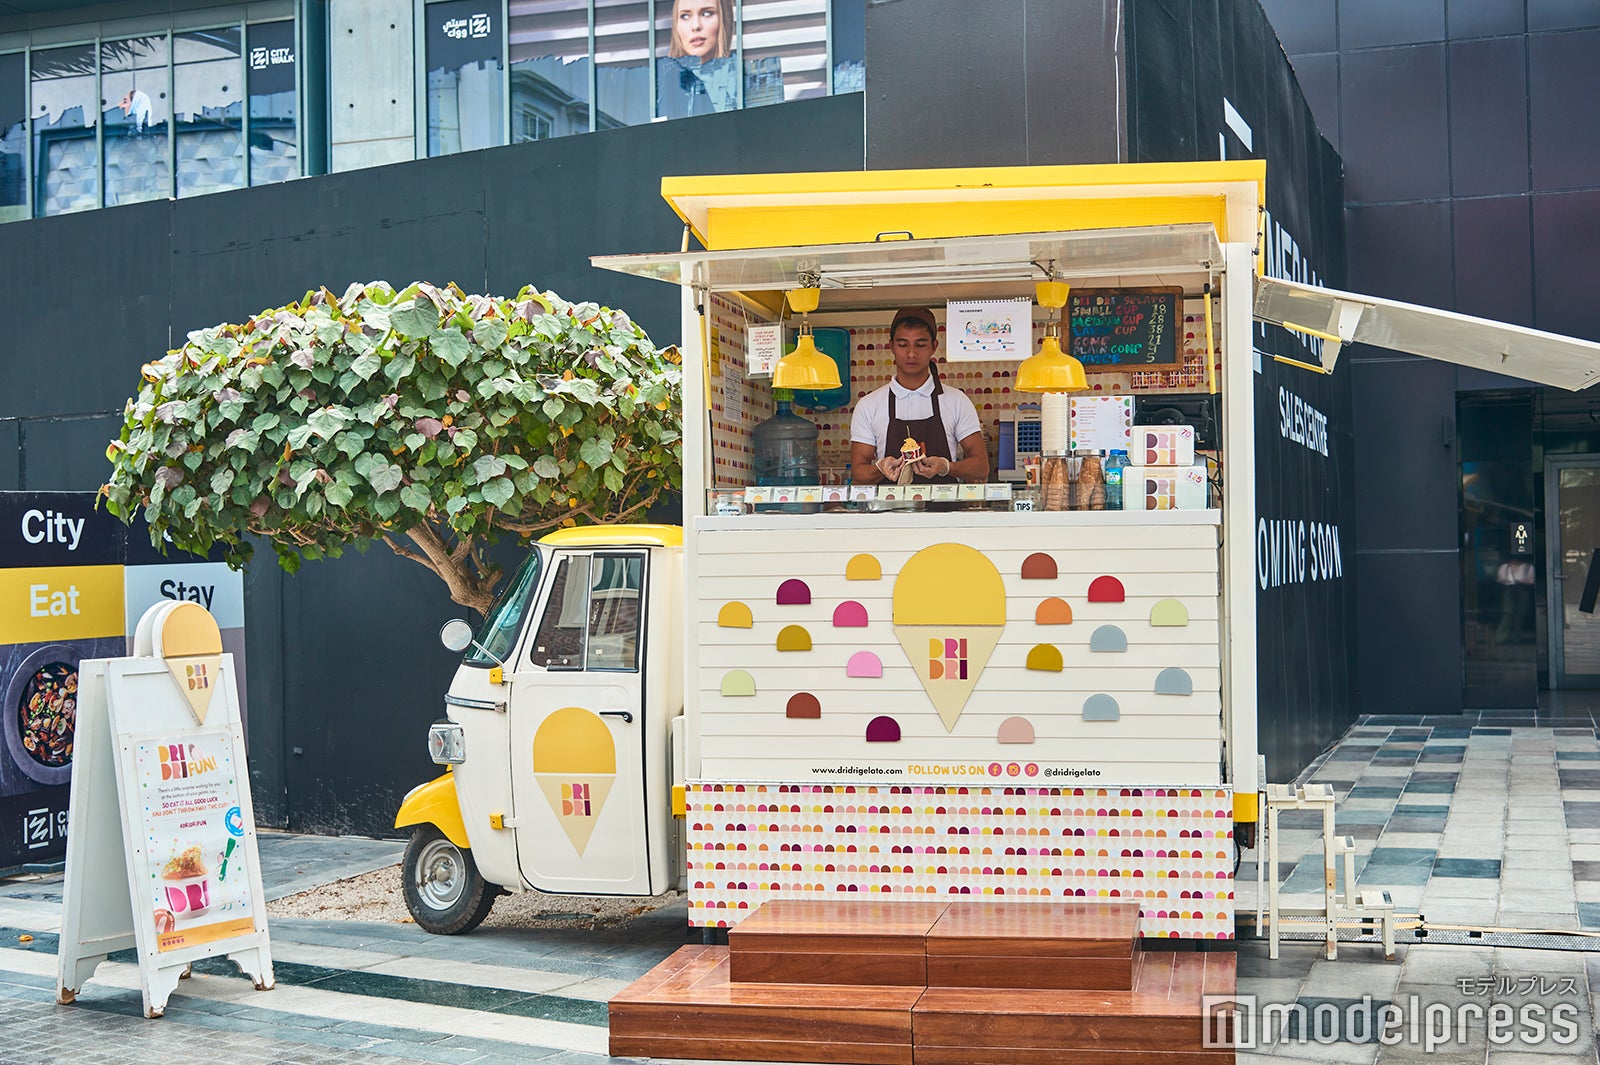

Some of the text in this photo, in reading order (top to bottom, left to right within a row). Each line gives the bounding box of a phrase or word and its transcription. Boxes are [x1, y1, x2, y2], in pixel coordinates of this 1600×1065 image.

[271, 48, 290, 57] CITY
[271, 55, 295, 65] WALK
[1072, 304, 1167, 317] SMALL CUP 18
[1122, 313, 1144, 325] CUP
[1149, 315, 1165, 325] 28
[1114, 325, 1137, 335] CUP
[1148, 324, 1164, 334] 38
[1073, 336, 1111, 346] CONE
[1073, 345, 1108, 355] PLAIN
[1110, 343, 1143, 355] CONE
[1146, 352, 1155, 363] 5
[1279, 386, 1329, 458] SALES CENTRE
[1181, 428, 1192, 438] 70
[1146, 433, 1176, 449] DRI
[1146, 449, 1176, 465] DRI
[1187, 471, 1203, 484] 125
[1146, 479, 1176, 495] DRI
[1016, 503, 1031, 511] TIPS
[1146, 495, 1176, 510] DRI
[21, 508, 86, 551] City
[1257, 517, 1343, 590] OMING SOON
[29, 583, 81, 618] Eat
[160, 579, 215, 611] Stay
[929, 637, 968, 659] DRI
[186, 663, 207, 677] DRI
[929, 659, 968, 680] DRI
[187, 676, 209, 691] DRI
[158, 743, 186, 763] DRI
[161, 755, 218, 781] DRI FUN!
[811, 764, 1101, 778] www.dridrigelato.com FOLLOW US ON @dridrigelato
[561, 783, 590, 800] DRI
[194, 797, 206, 805] GOOD
[562, 799, 592, 817] DRI
